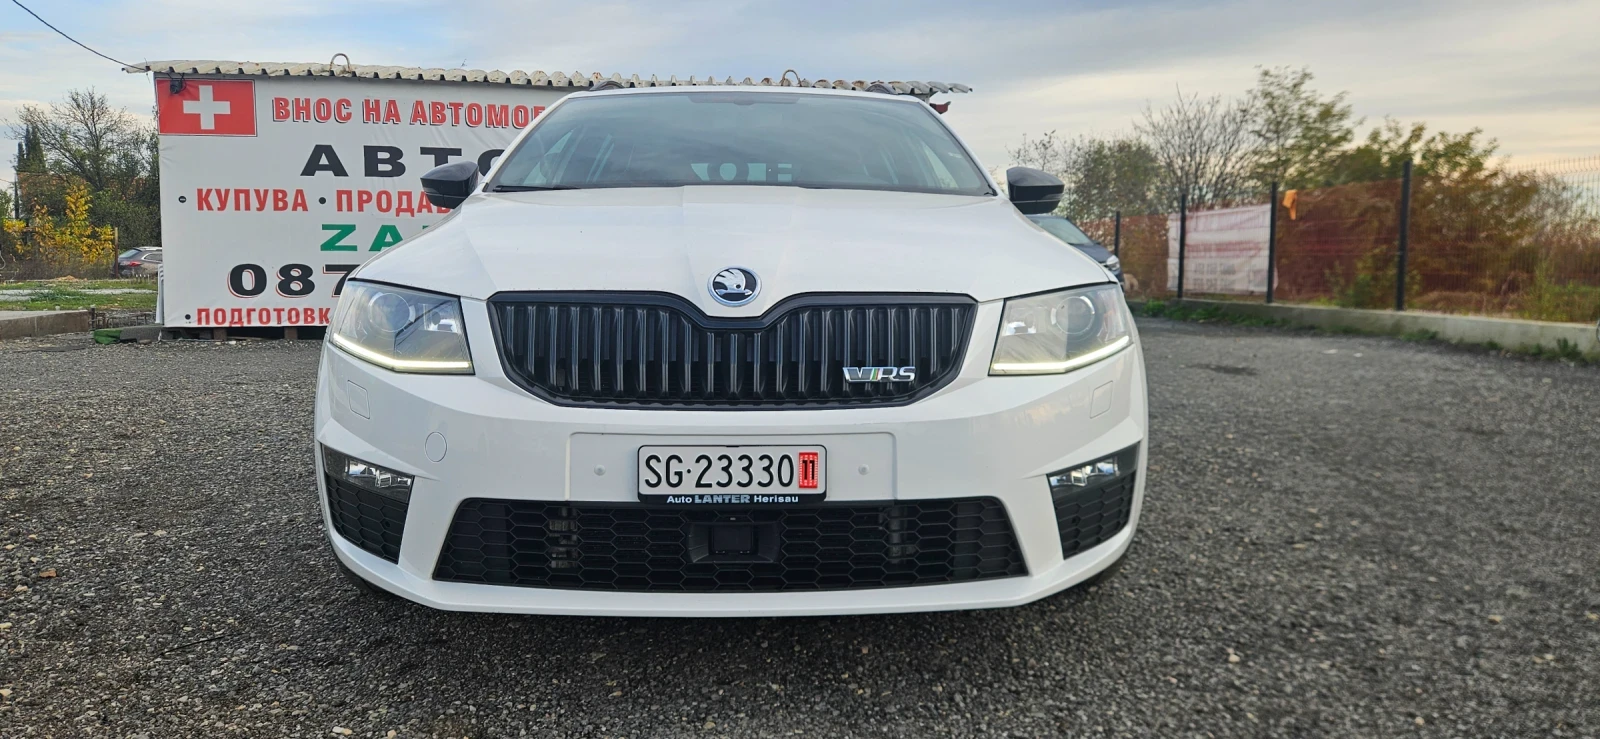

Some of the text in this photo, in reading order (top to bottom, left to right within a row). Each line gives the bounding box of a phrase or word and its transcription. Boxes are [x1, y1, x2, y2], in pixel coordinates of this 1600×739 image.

[272, 97, 545, 129] ВНОС НА АВТОМО
[196, 188, 451, 218] КУПУВА ПРОДА
[320, 223, 430, 252] ZA
[667, 494, 799, 504] Auto LANTER Herisau
